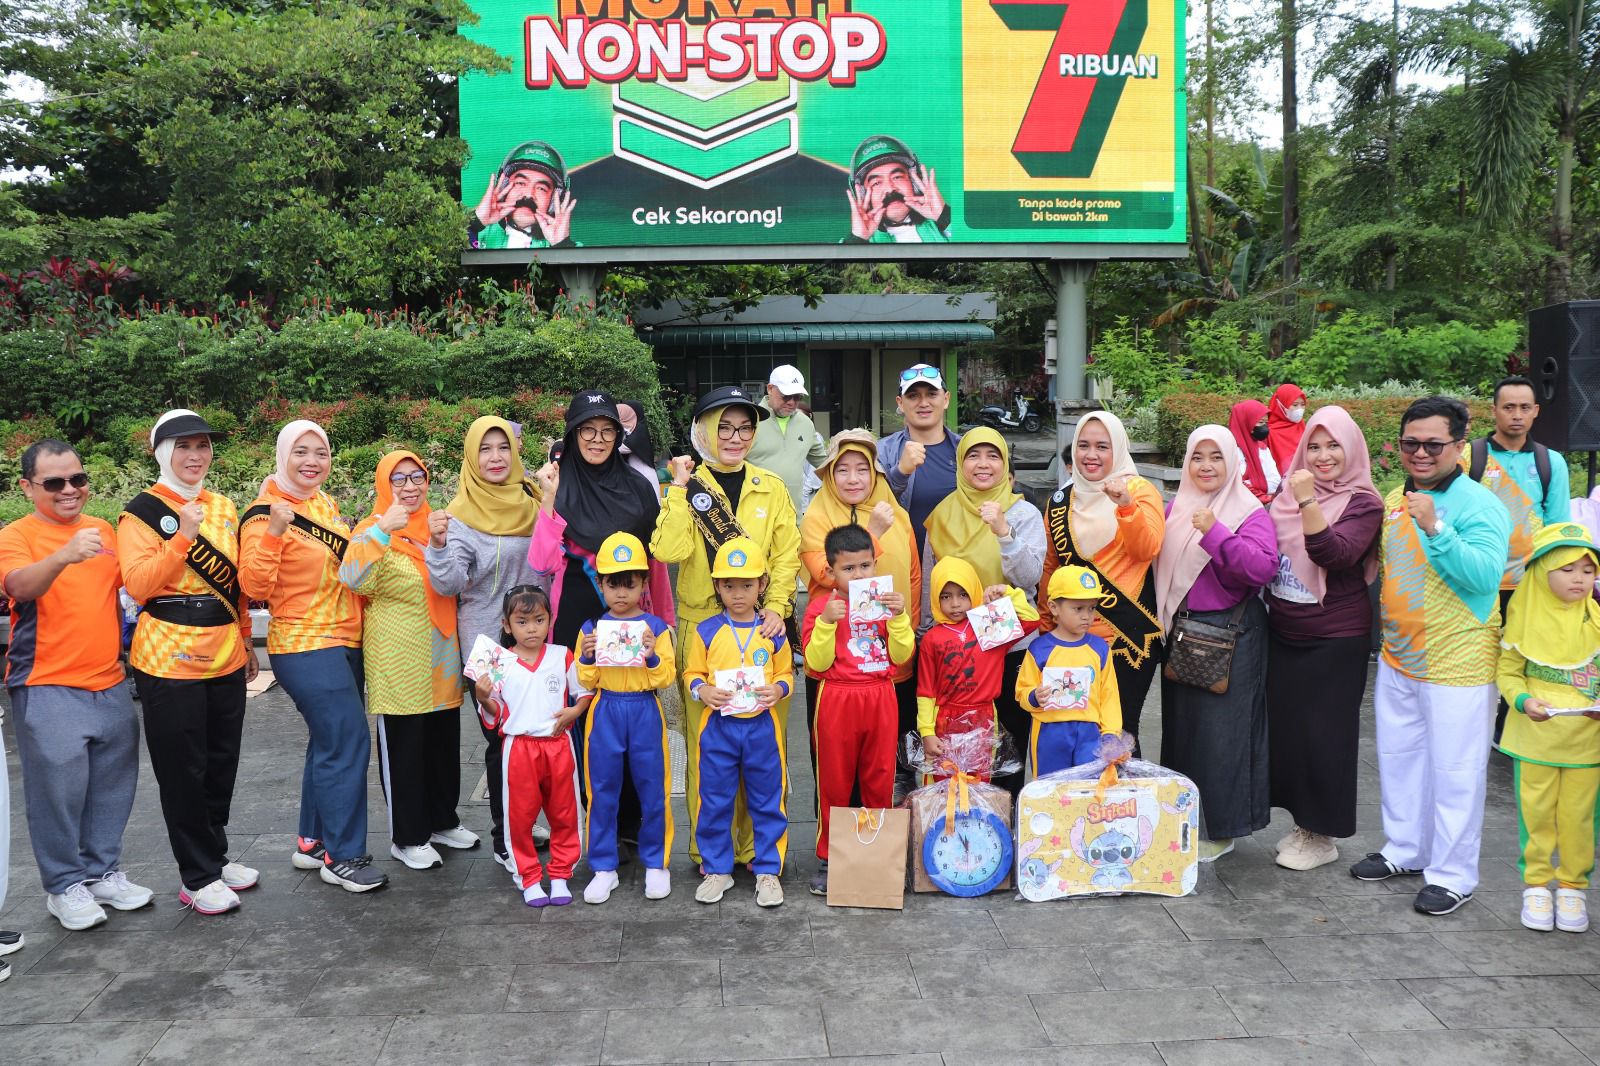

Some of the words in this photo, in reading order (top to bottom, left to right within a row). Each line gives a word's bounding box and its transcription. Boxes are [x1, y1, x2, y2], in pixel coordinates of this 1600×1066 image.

[527, 15, 885, 86] NON-STOP
[1059, 54, 1157, 77] RIBUAN
[1018, 198, 1054, 210] Tanpa
[1055, 197, 1083, 209] kode
[1085, 199, 1122, 211] promo
[632, 207, 671, 225] Cek
[676, 206, 783, 228] Sekarang!
[1032, 211, 1044, 222] Di
[1045, 211, 1084, 222] bawah
[1085, 211, 1109, 222] 2km
[707, 507, 734, 534] Bunda
[1050, 505, 1073, 566] BUNDA
